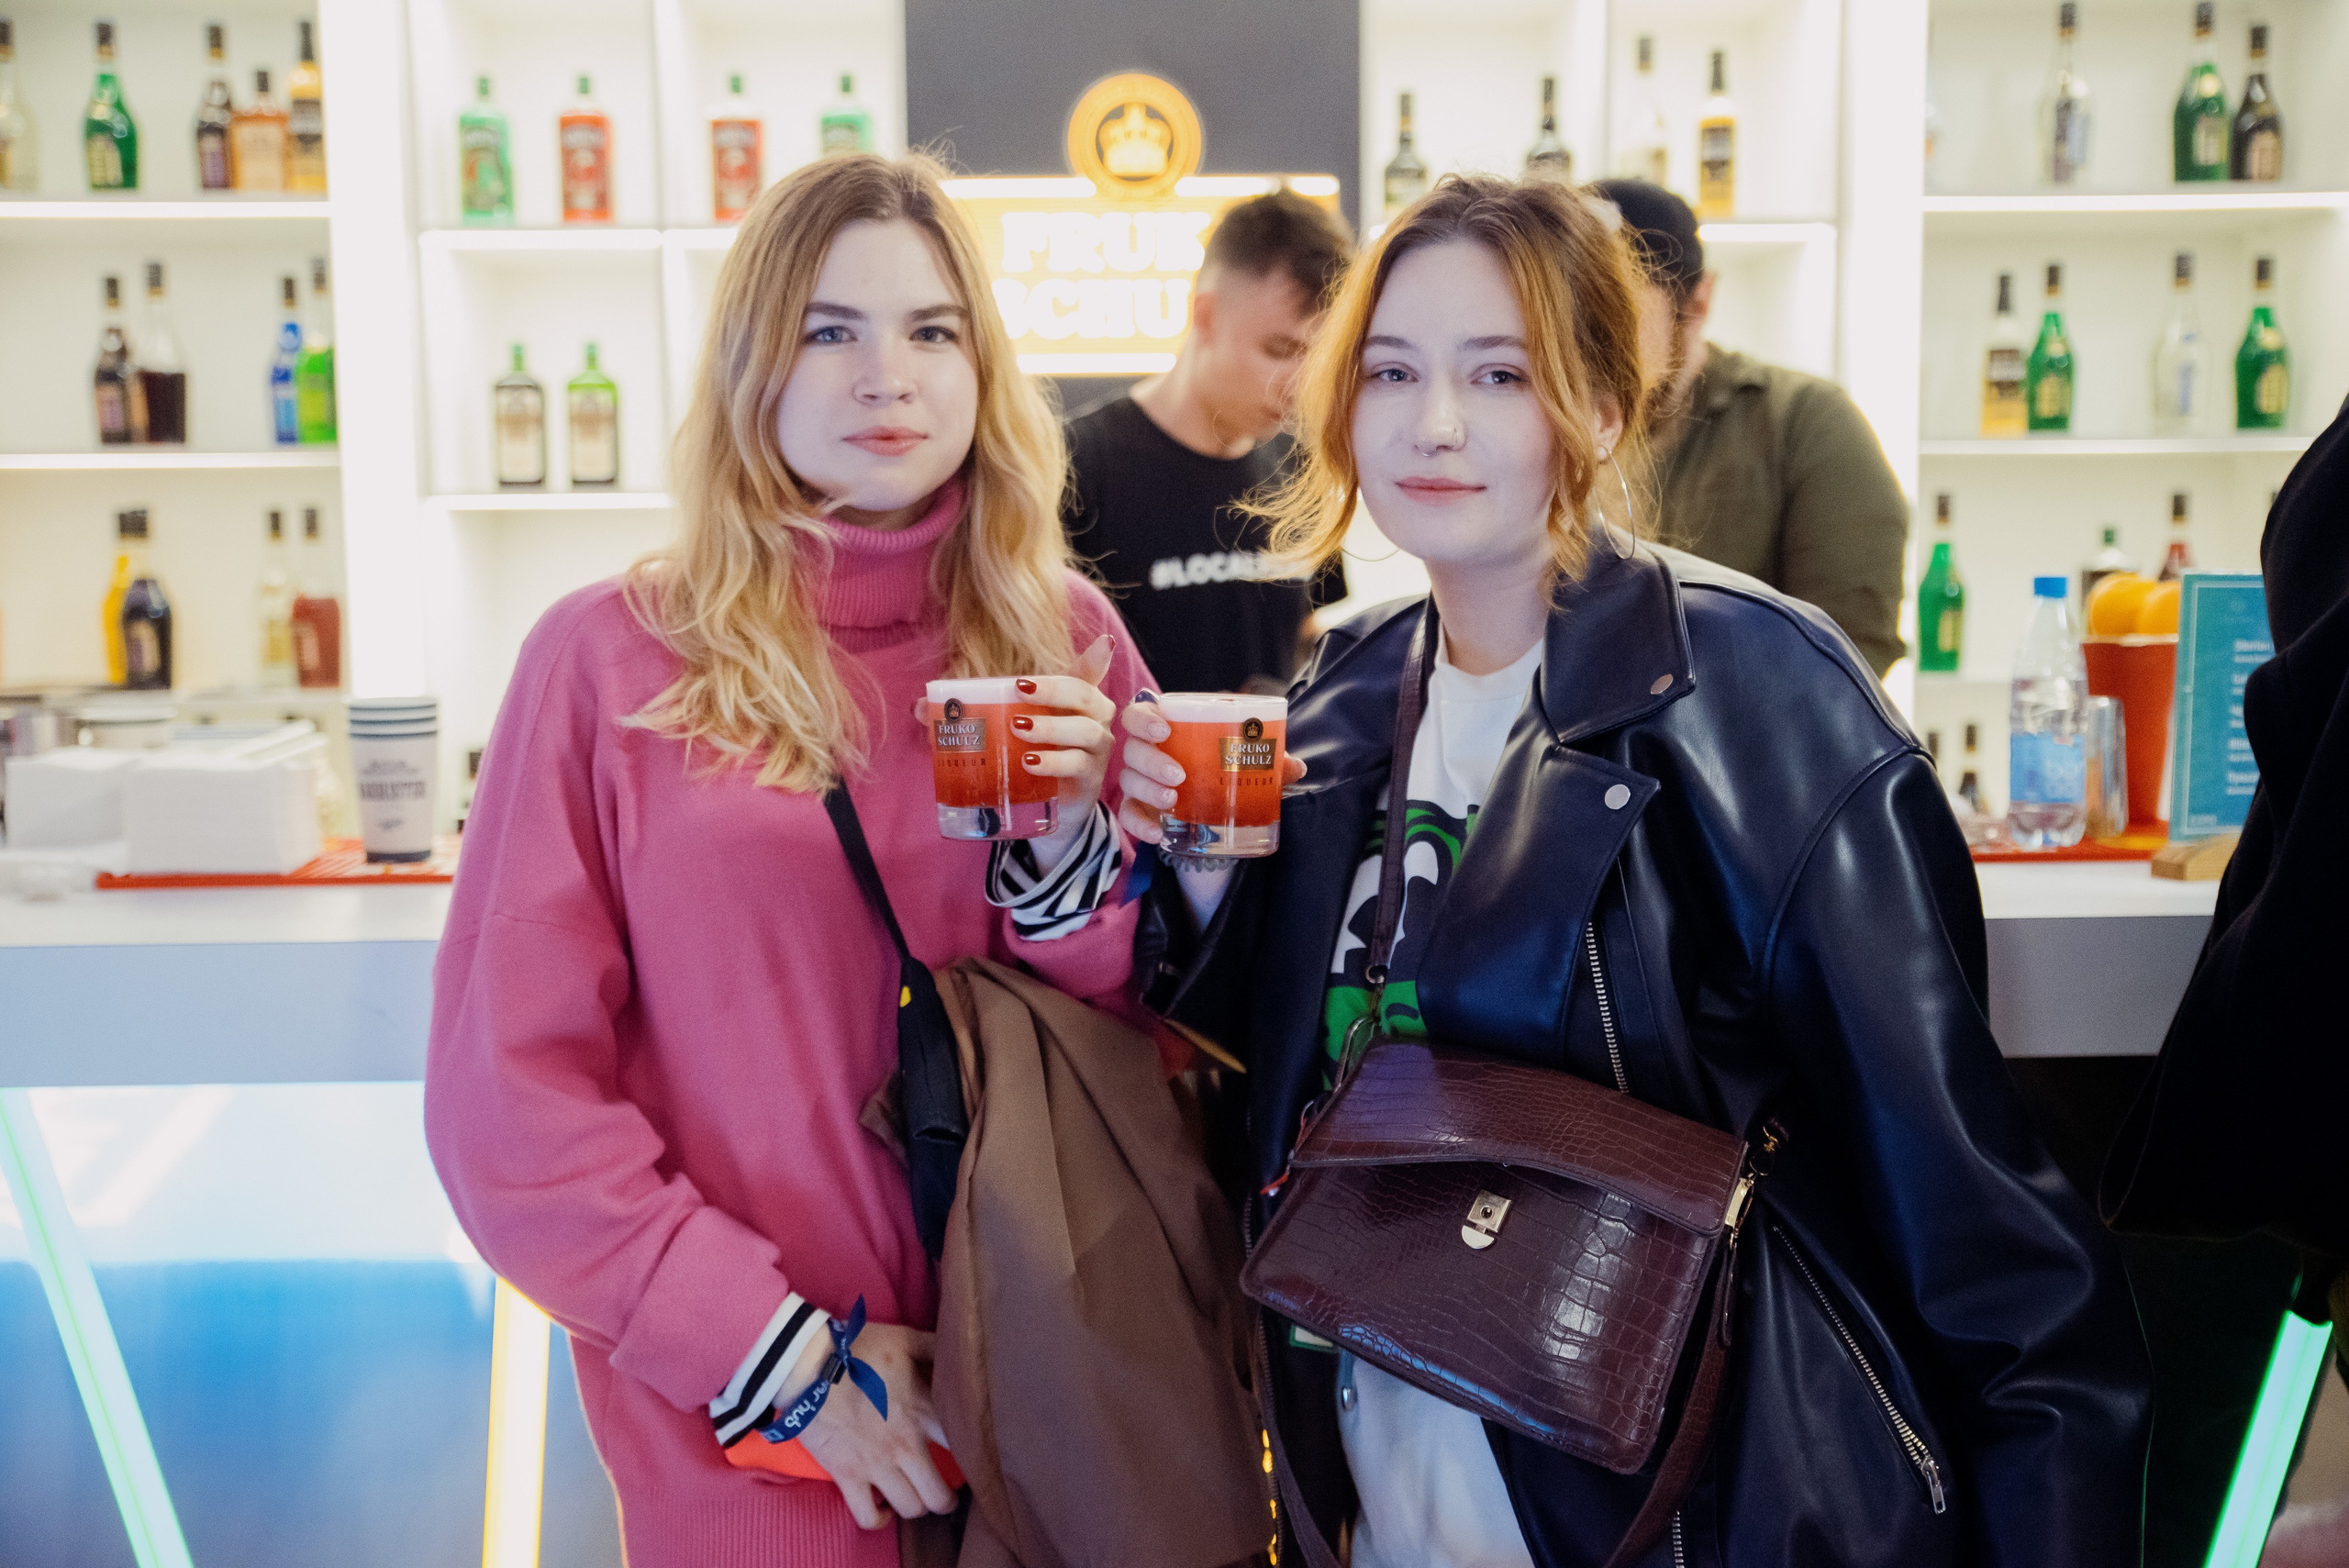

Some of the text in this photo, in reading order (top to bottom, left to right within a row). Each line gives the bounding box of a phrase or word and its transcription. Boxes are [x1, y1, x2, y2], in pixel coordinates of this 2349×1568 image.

[1001, 211, 1212, 272] FRUK
[991, 278, 1191, 339] SCHU
[938, 724, 976, 735] FRUKO
[937, 735, 982, 746] SCHULZ
[1230, 742, 1271, 753] FRUKO
[1224, 754, 1273, 765] SCHULZ
[785, 1398, 817, 1429] hub
